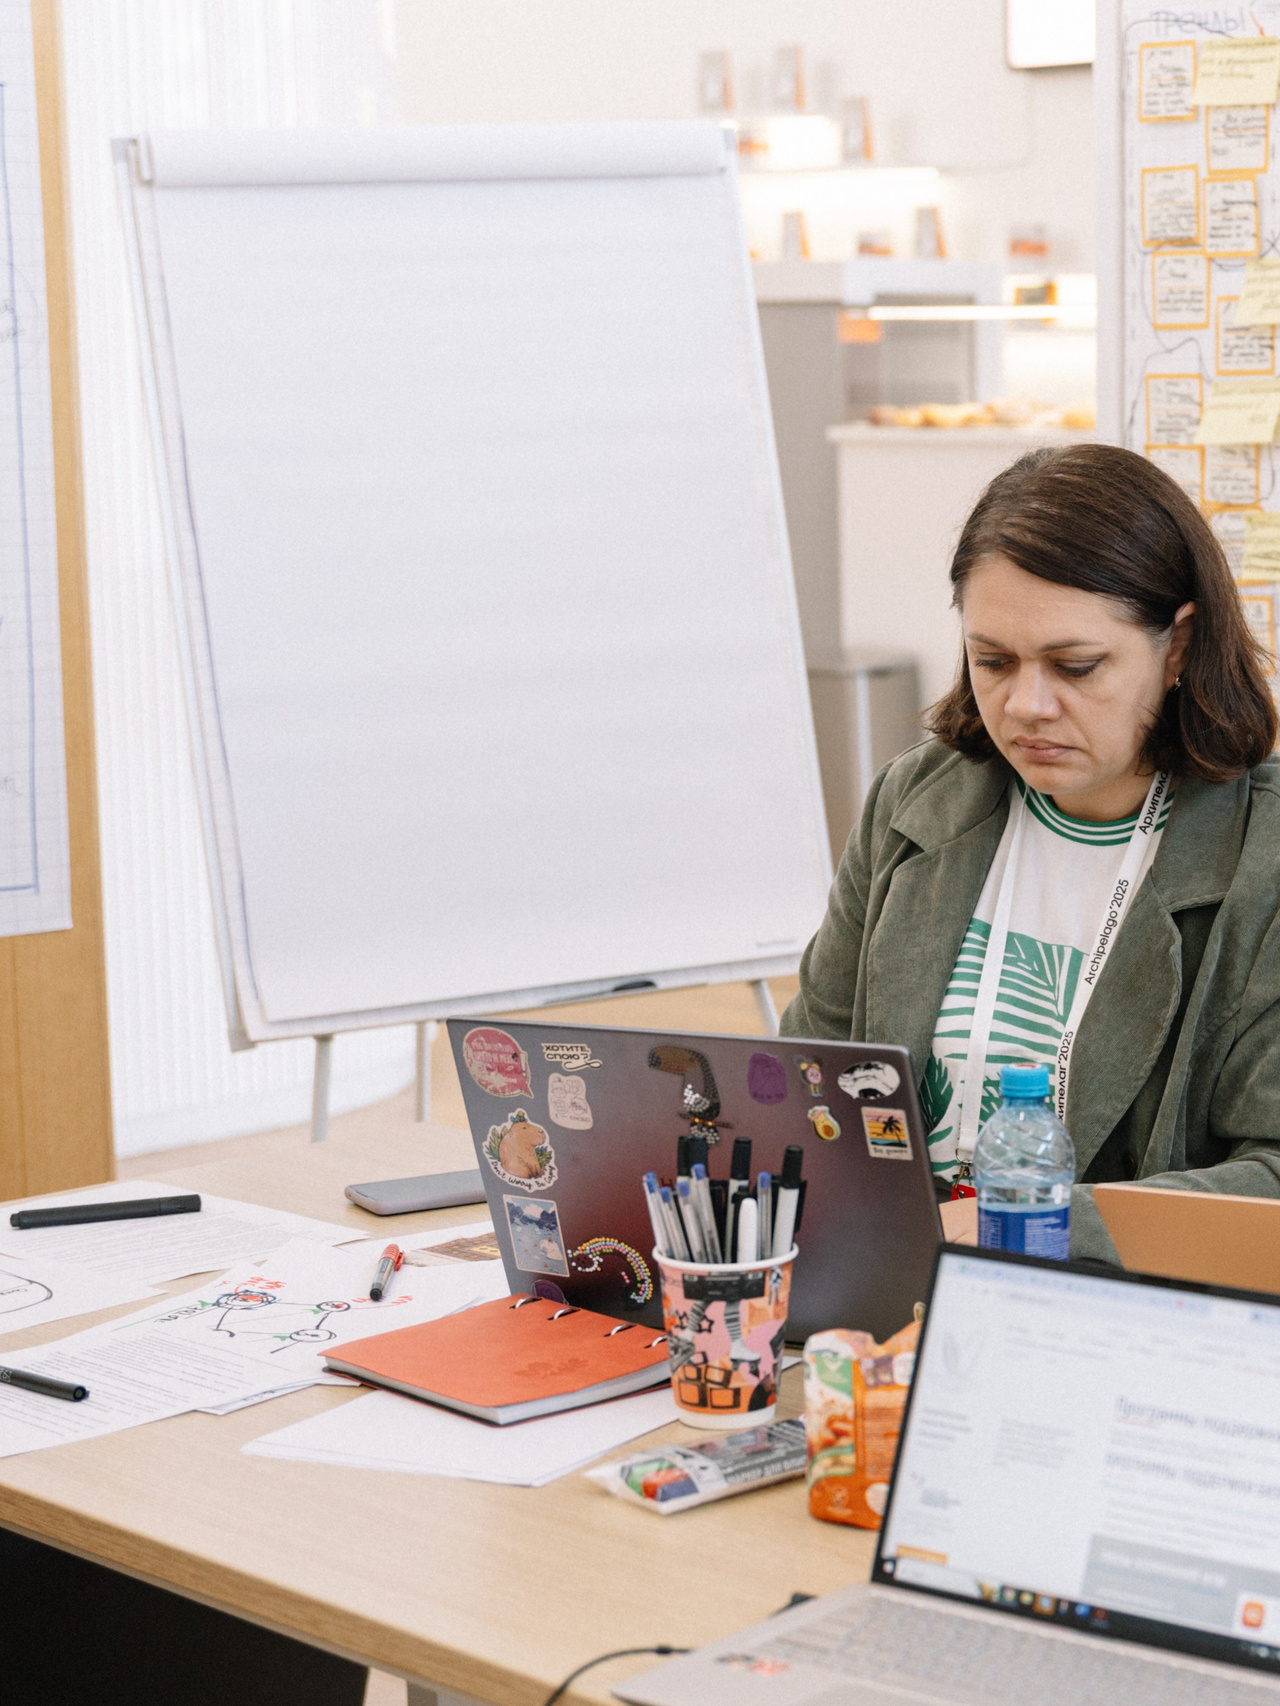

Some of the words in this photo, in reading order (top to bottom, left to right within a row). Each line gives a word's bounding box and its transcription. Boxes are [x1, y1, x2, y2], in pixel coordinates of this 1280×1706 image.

[1139, 770, 1171, 835] Архипела
[1084, 879, 1129, 985] Archipelago'2025
[1058, 1030, 1074, 1121] хипелаг'2025
